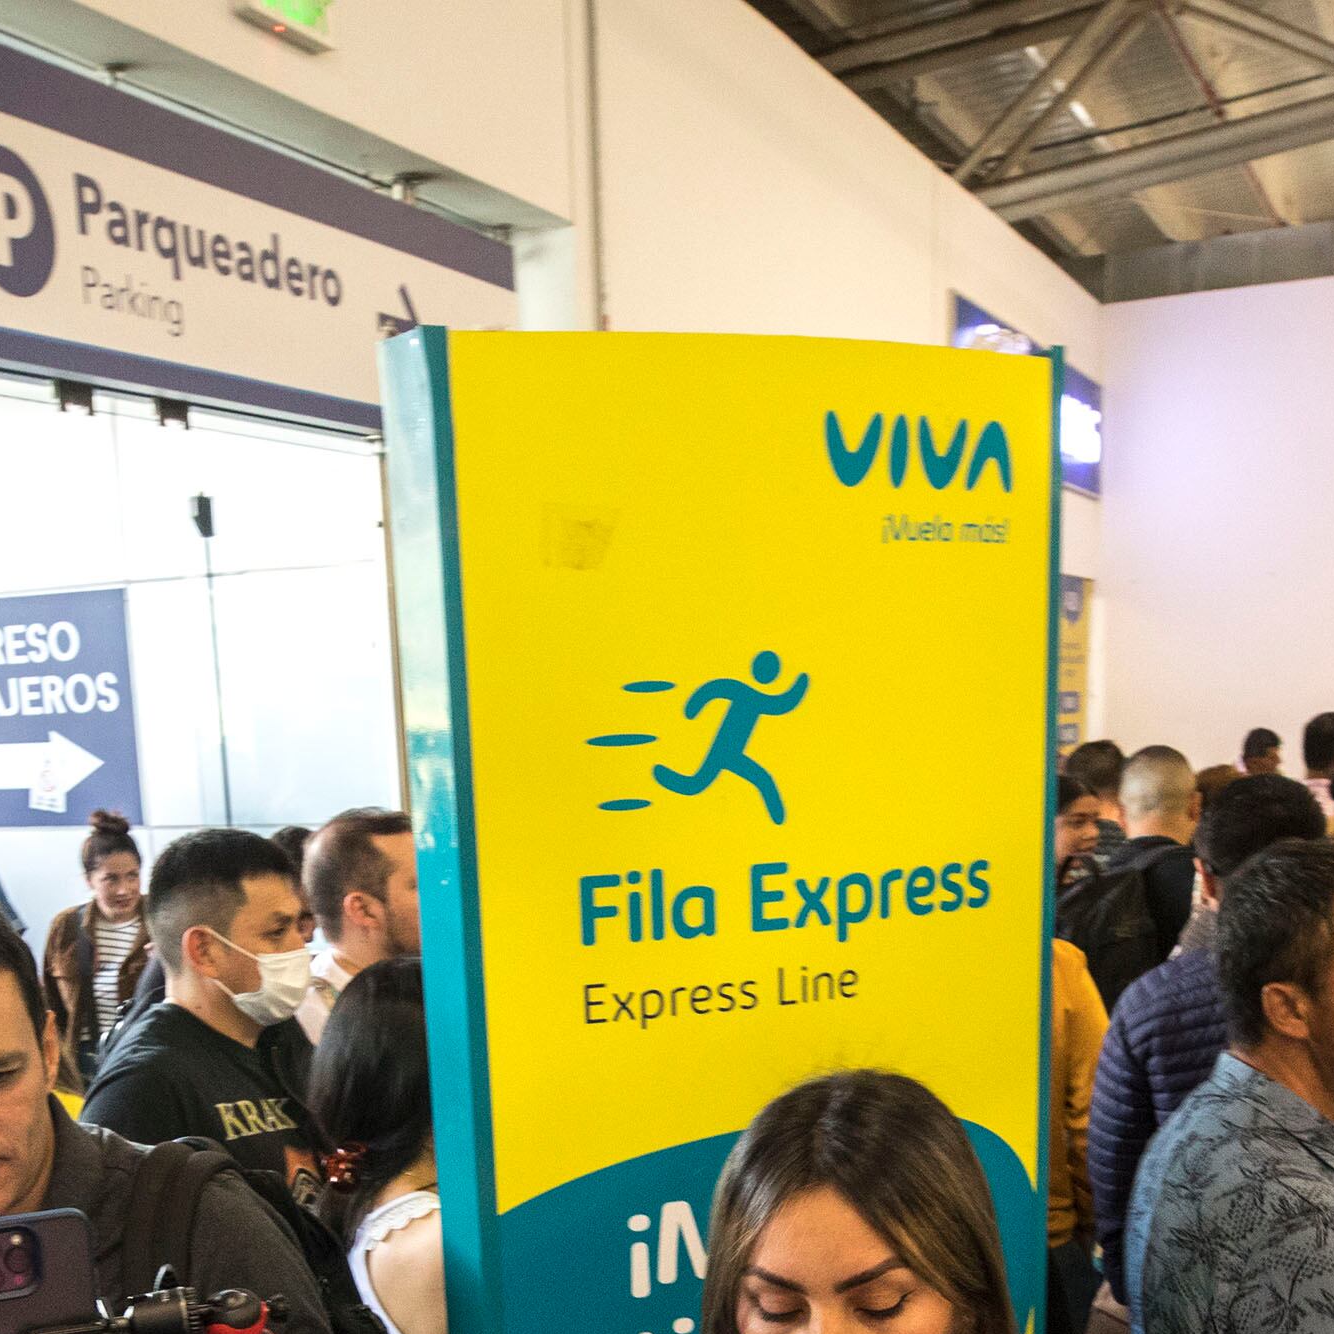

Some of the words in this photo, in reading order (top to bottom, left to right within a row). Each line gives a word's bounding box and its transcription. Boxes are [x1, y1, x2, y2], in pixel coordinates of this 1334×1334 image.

[74, 174, 343, 307] Parqueadero
[80, 267, 185, 336] Parking
[825, 410, 1012, 493] VIVA
[579, 868, 716, 946] Fila
[750, 858, 992, 943] Express
[583, 971, 759, 1029] Express
[777, 966, 860, 1008] Line
